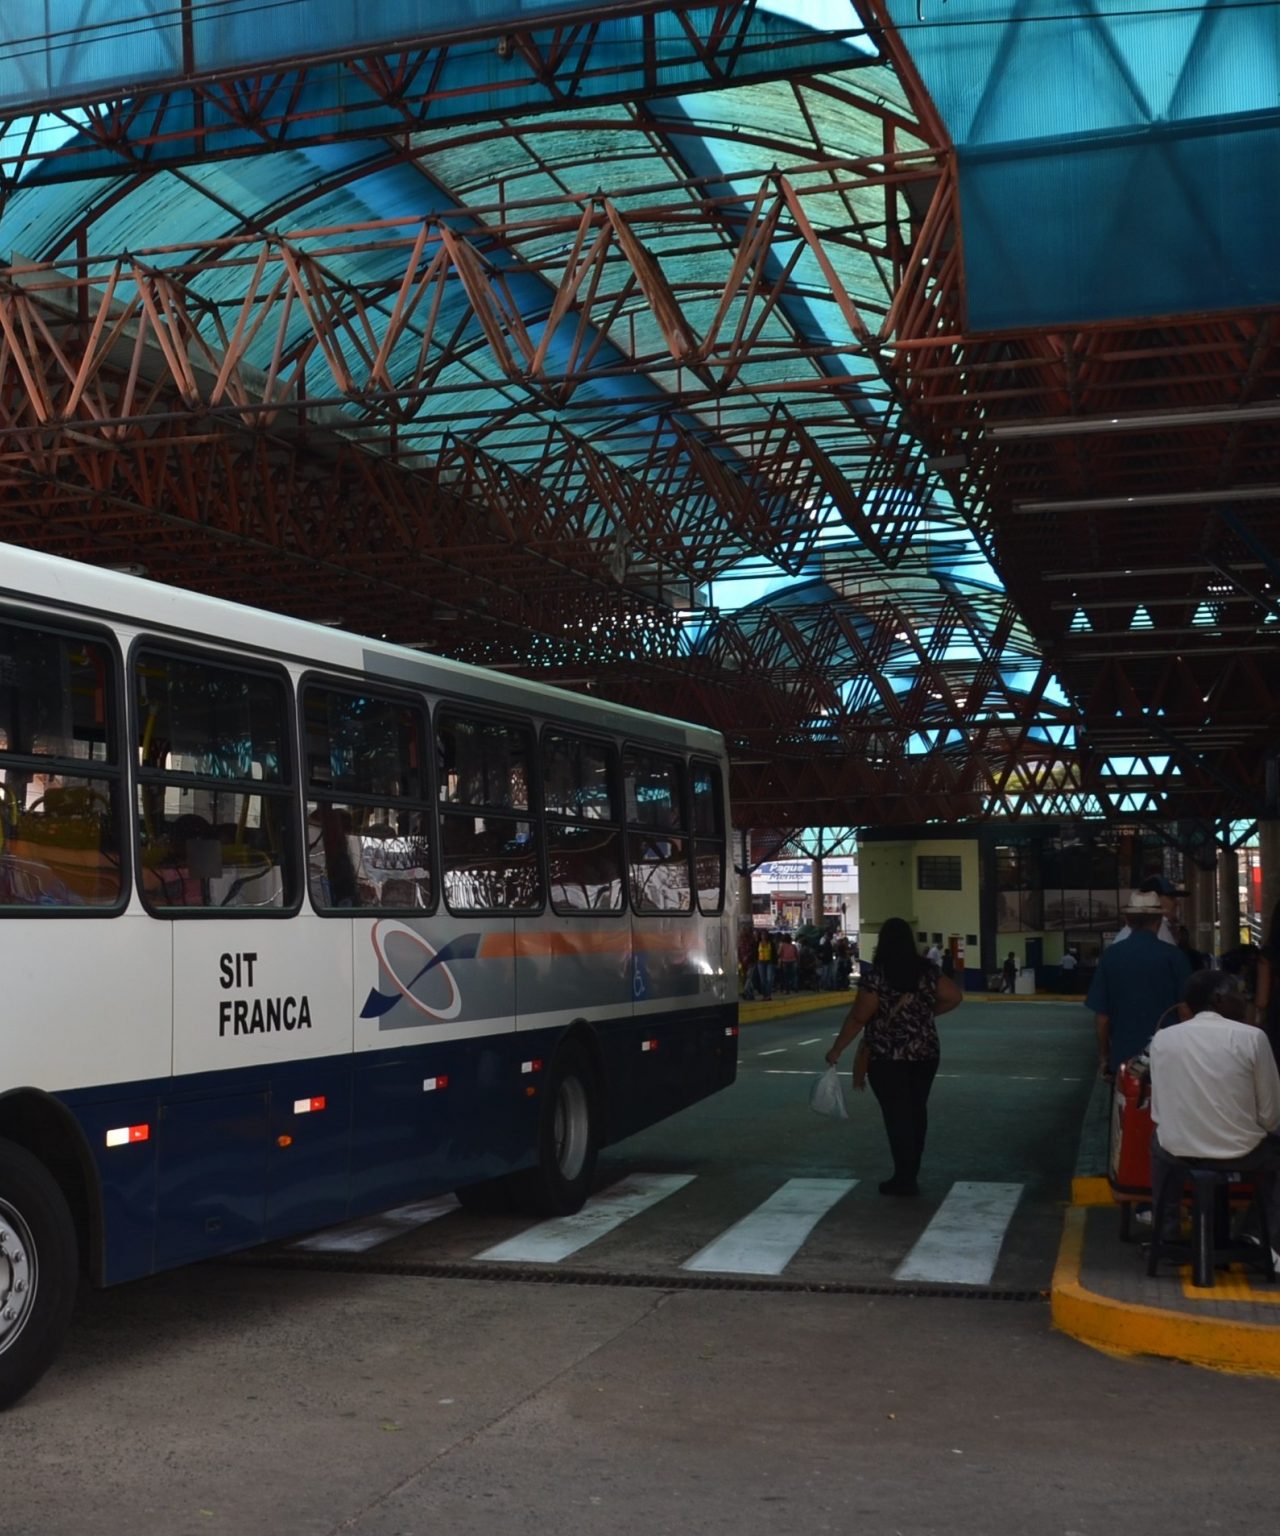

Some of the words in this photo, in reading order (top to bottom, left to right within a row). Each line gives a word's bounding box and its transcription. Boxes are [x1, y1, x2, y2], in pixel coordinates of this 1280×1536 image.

[769, 863, 804, 874] Pague
[219, 953, 258, 989] SIT
[219, 996, 312, 1037] FRANCA
